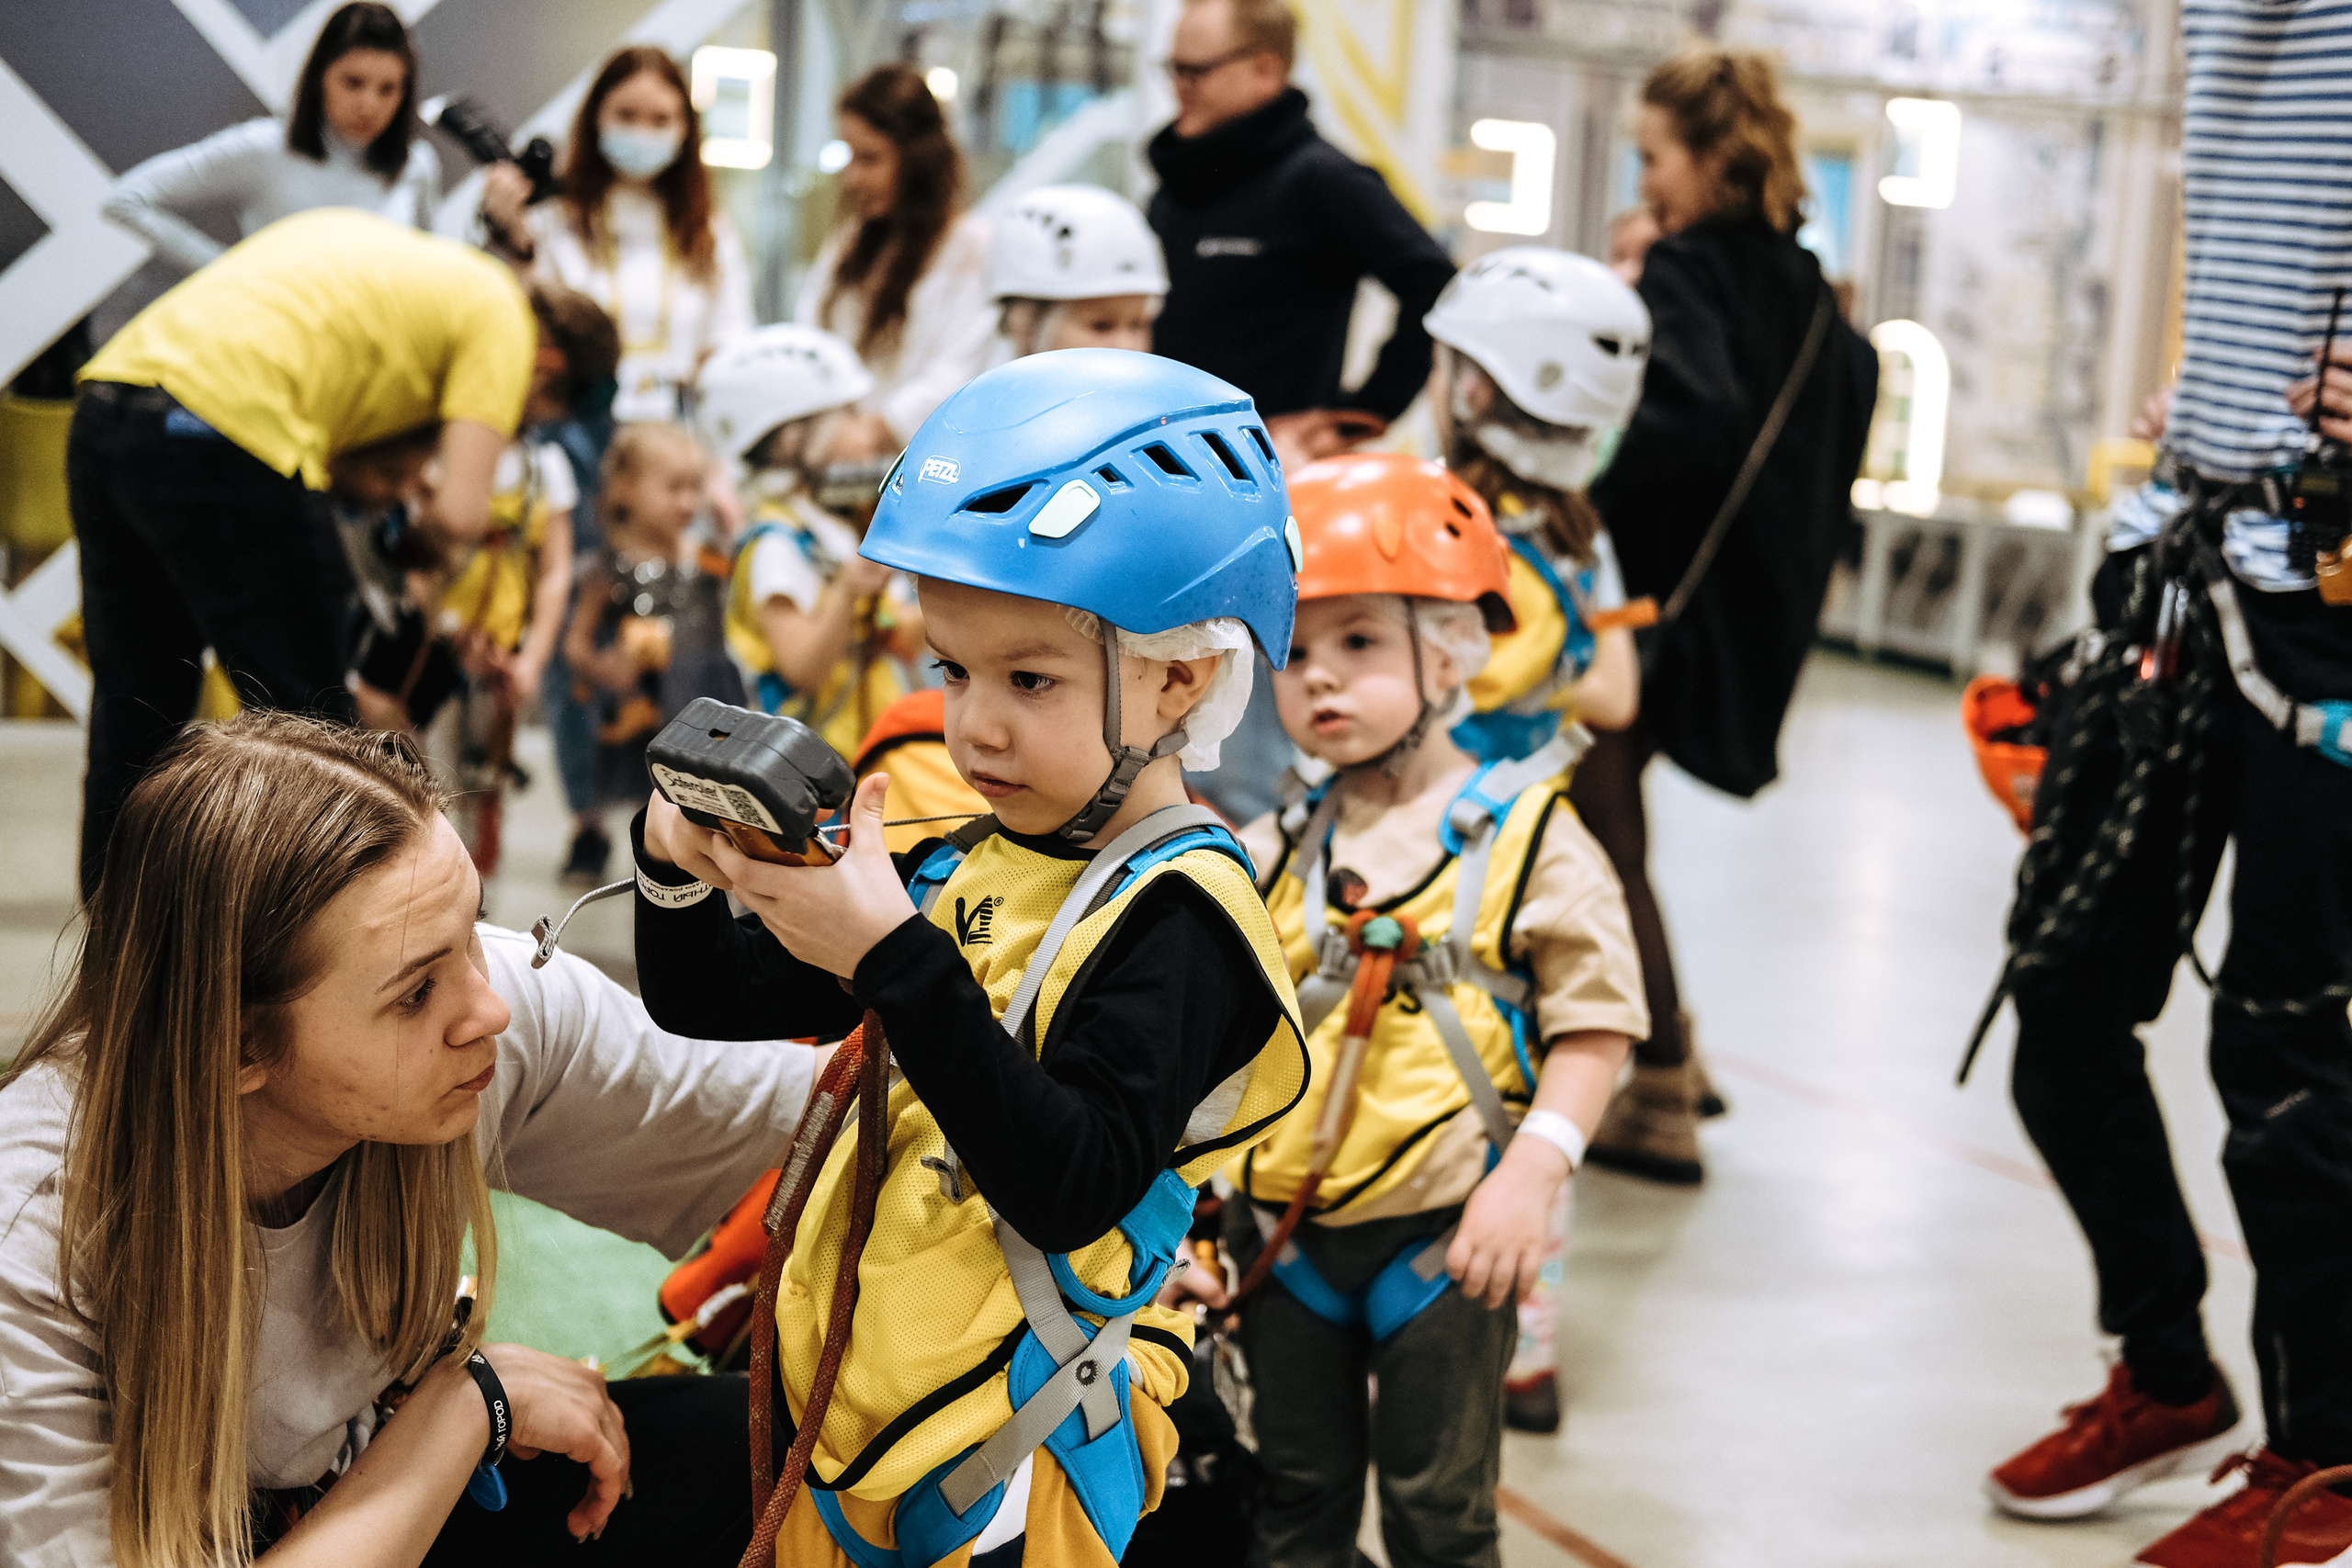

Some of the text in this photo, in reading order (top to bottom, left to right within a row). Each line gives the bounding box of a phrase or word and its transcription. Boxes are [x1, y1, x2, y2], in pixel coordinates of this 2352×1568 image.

[918, 458, 959, 483] PETZL
[638, 876, 710, 903] ТНЫЙ ГОРО
